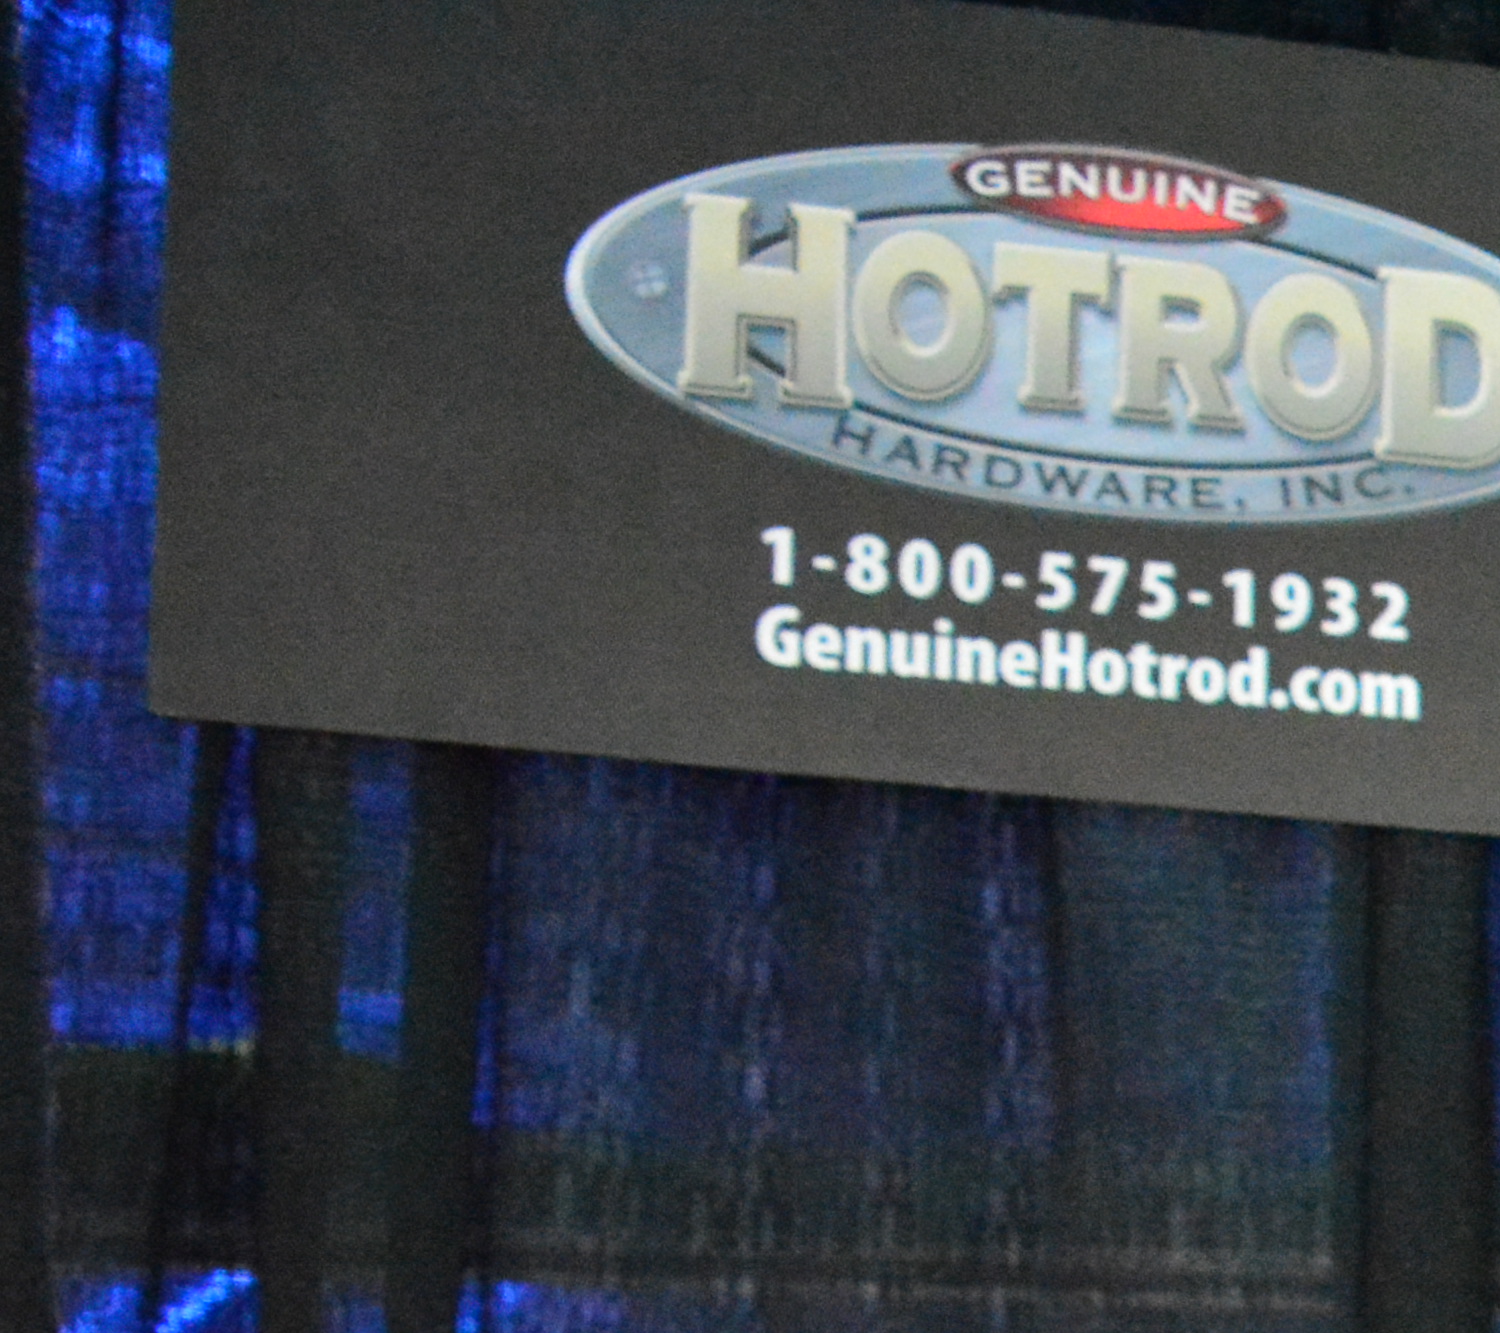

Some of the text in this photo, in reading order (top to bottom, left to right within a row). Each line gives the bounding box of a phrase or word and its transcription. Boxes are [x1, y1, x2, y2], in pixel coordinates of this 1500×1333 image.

[964, 160, 1262, 226] GENUINE
[830, 408, 1416, 513] HARDWARE, INC.
[759, 525, 1412, 642] 1-800-575-1932
[755, 605, 1423, 722] GenuineHotrod.com
